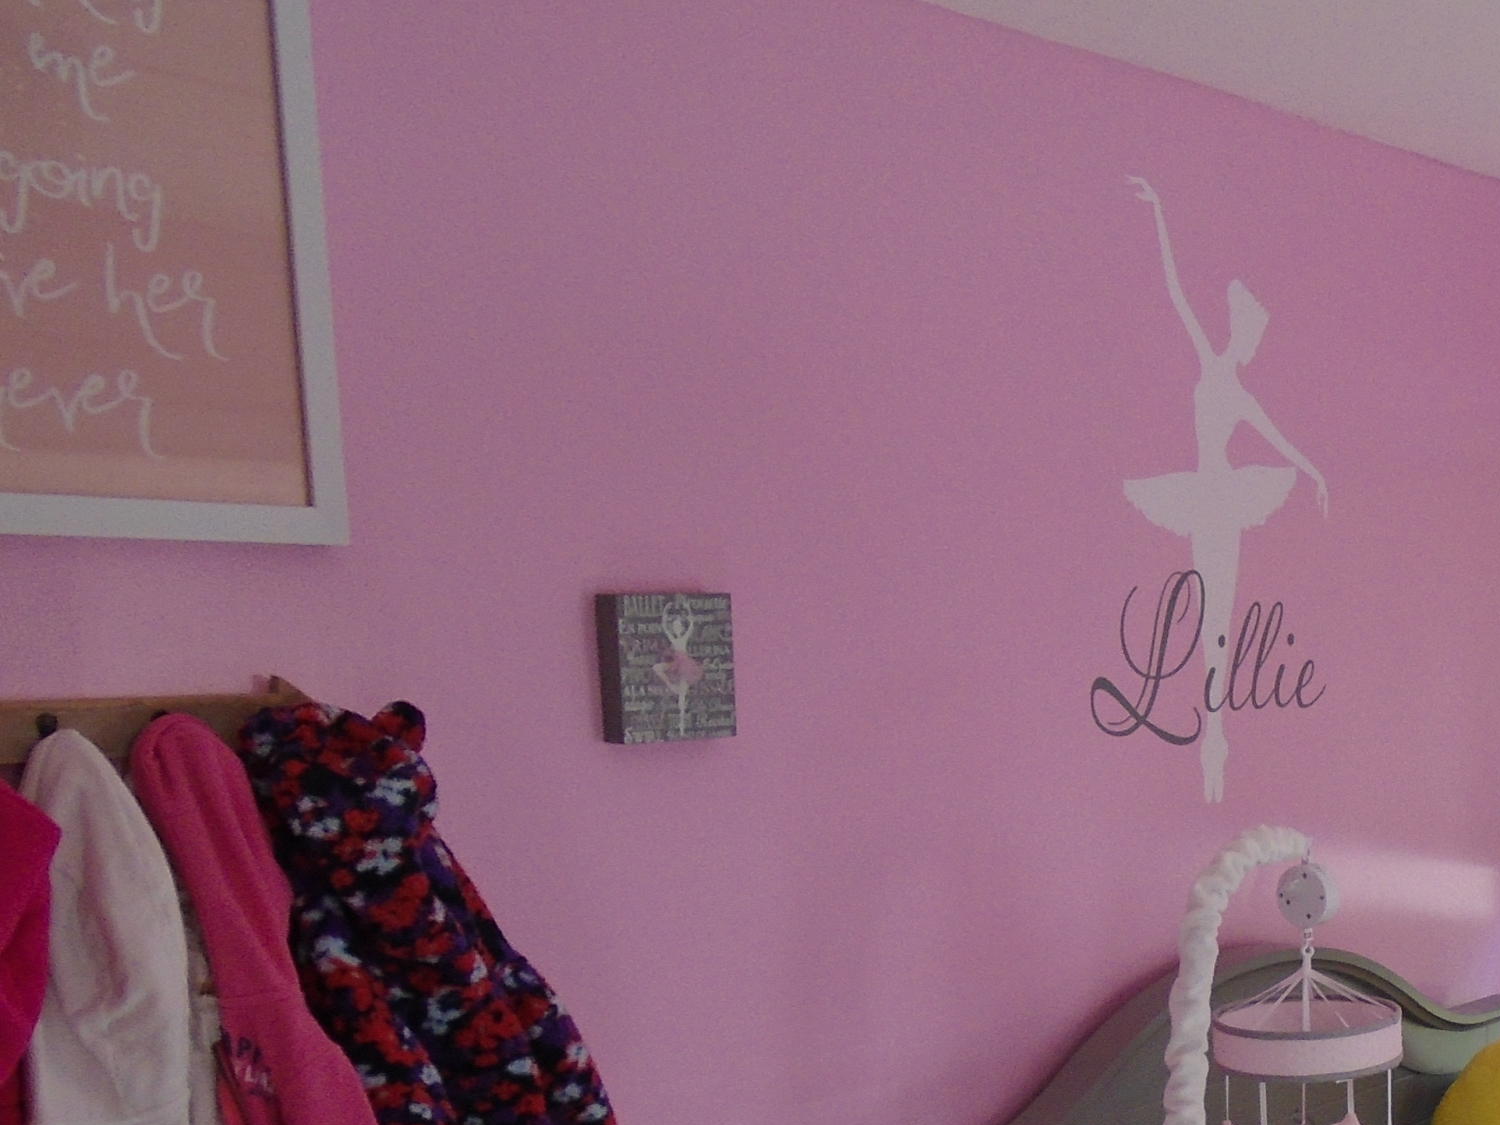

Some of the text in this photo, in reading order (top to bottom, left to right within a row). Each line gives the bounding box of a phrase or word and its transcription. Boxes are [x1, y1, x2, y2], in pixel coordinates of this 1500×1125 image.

[0, 150, 163, 253] going
[0, 242, 230, 362] ve her
[1090, 569, 1327, 746] Lillie
